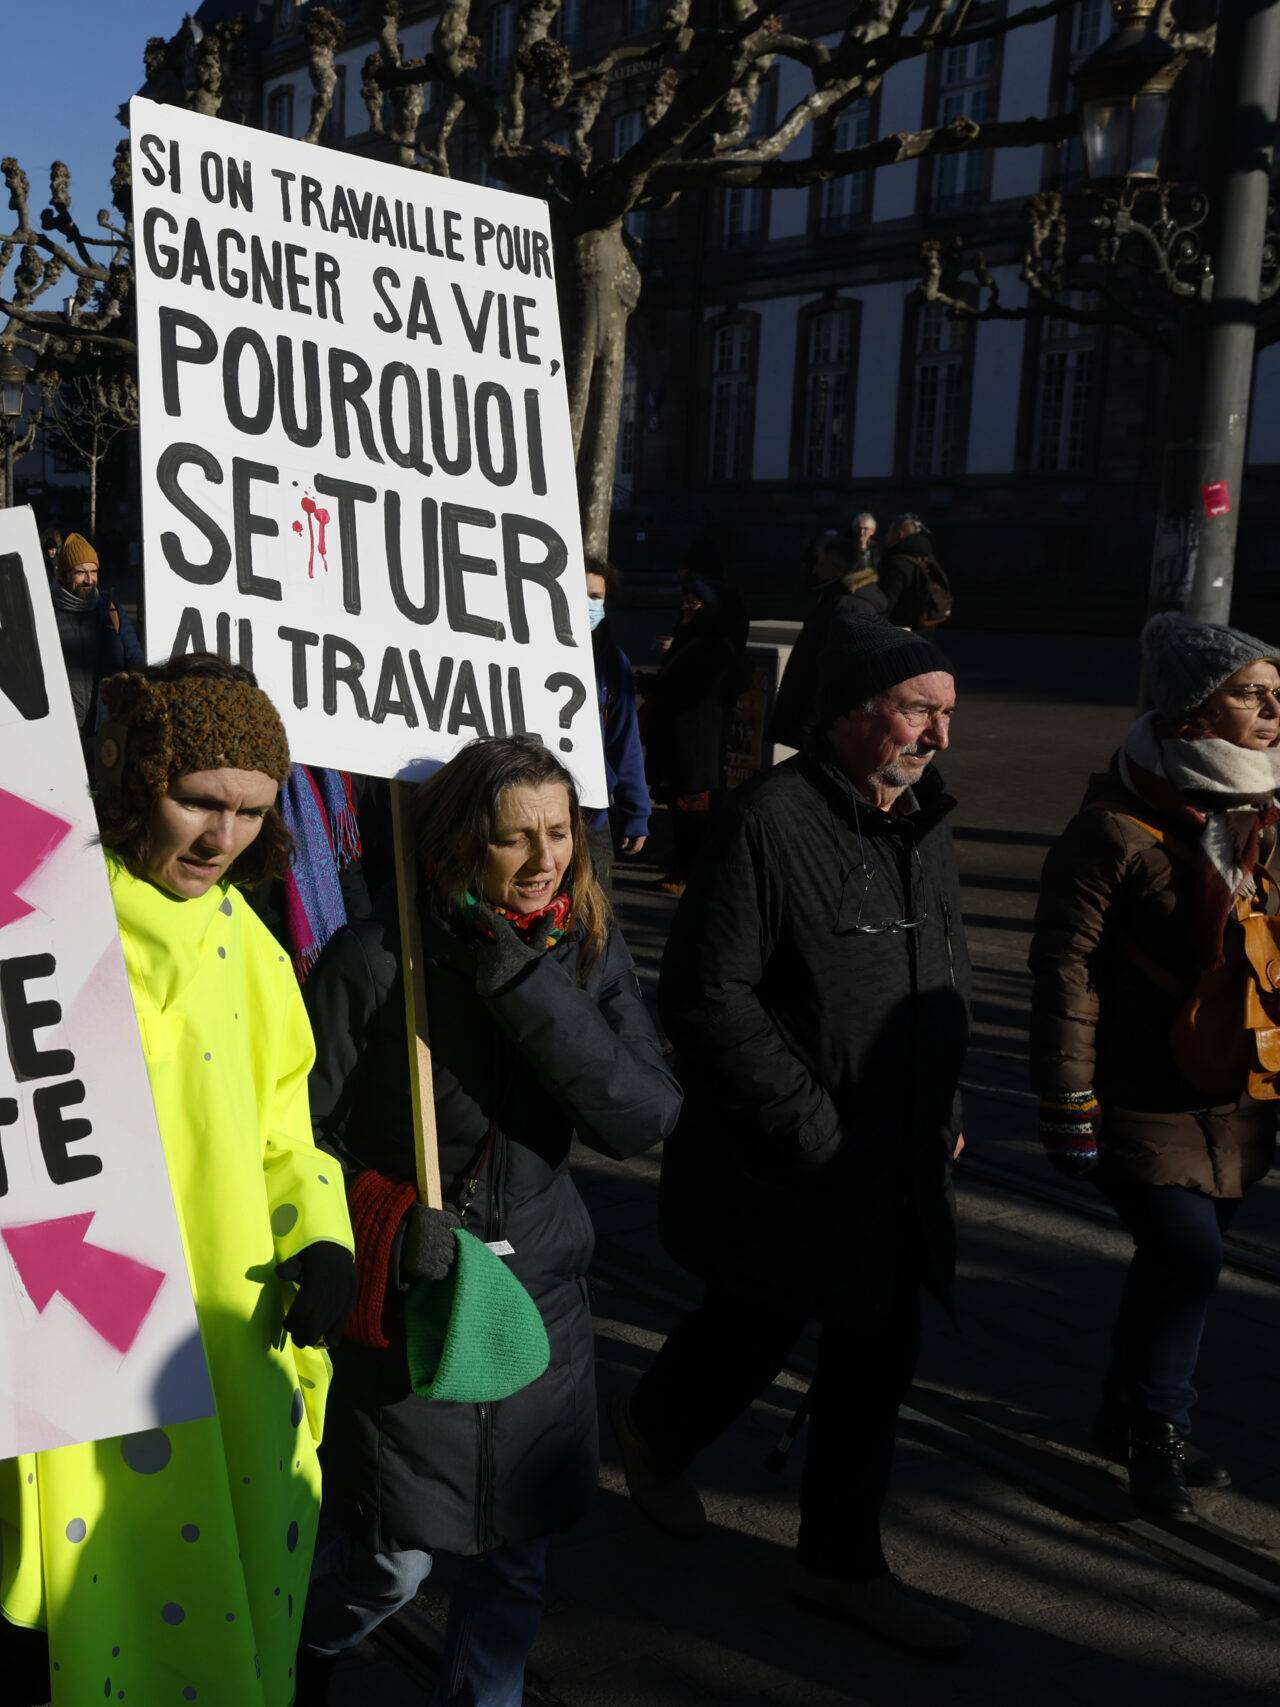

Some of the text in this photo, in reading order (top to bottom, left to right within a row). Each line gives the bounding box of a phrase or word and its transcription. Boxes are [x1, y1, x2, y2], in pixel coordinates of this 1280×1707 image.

[140, 134, 553, 280] SI ON TRAVAILLE POUR
[143, 207, 561, 377] GAGNER SA VIE,
[158, 306, 547, 497] POURQUOI
[156, 442, 579, 648] SE TUER
[278, 625, 543, 745] TRAVAIL
